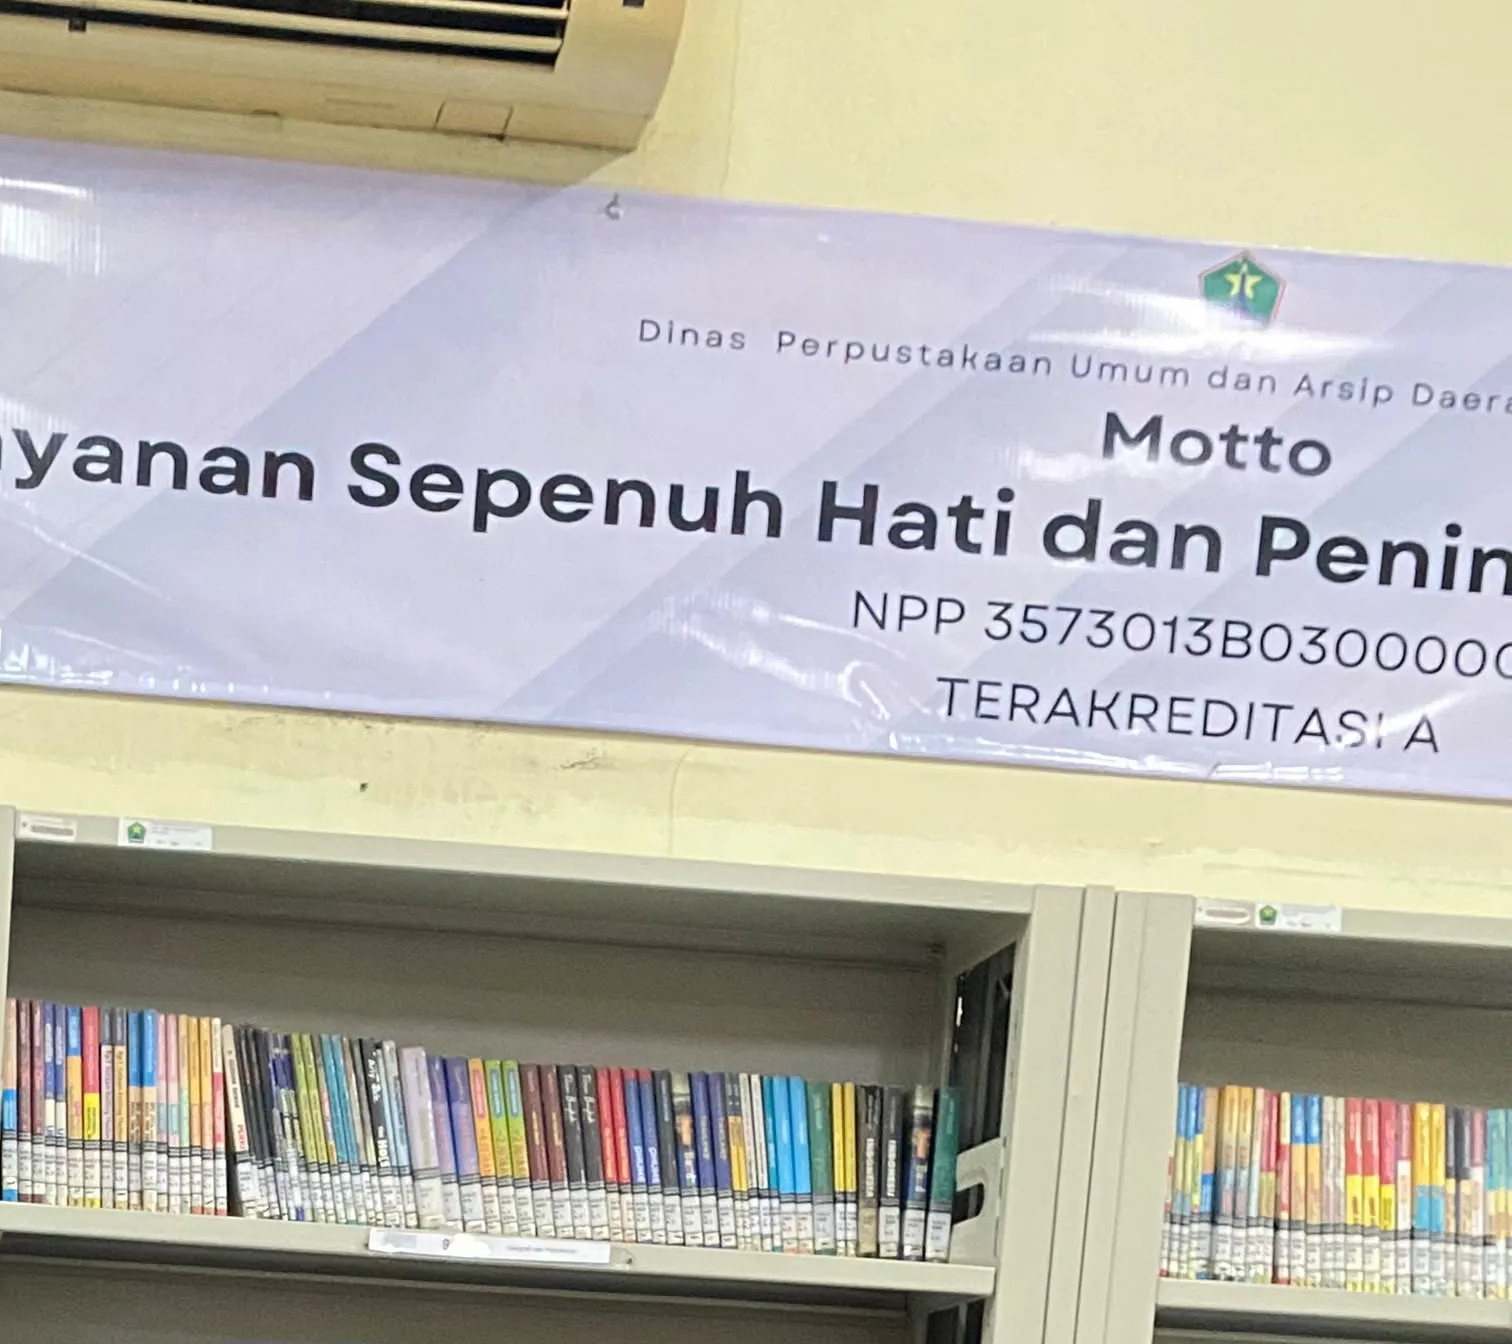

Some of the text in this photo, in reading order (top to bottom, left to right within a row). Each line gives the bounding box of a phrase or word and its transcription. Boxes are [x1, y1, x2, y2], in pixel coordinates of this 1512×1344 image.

[638, 316, 748, 353] Dinas
[774, 329, 1054, 378] Perpustakaan
[1070, 351, 1191, 389] Umum
[1206, 364, 1277, 396] dan
[1293, 373, 1394, 409] Arsip
[1100, 410, 1333, 478] Motto
[347, 442, 783, 538] Sepenuh
[815, 478, 1015, 556] Hati
[1041, 497, 1223, 573] dan
[1255, 514, 1512, 597] Penin
[850, 590, 967, 639] NPP
[937, 675, 1441, 757] TERAKREDITASI A
